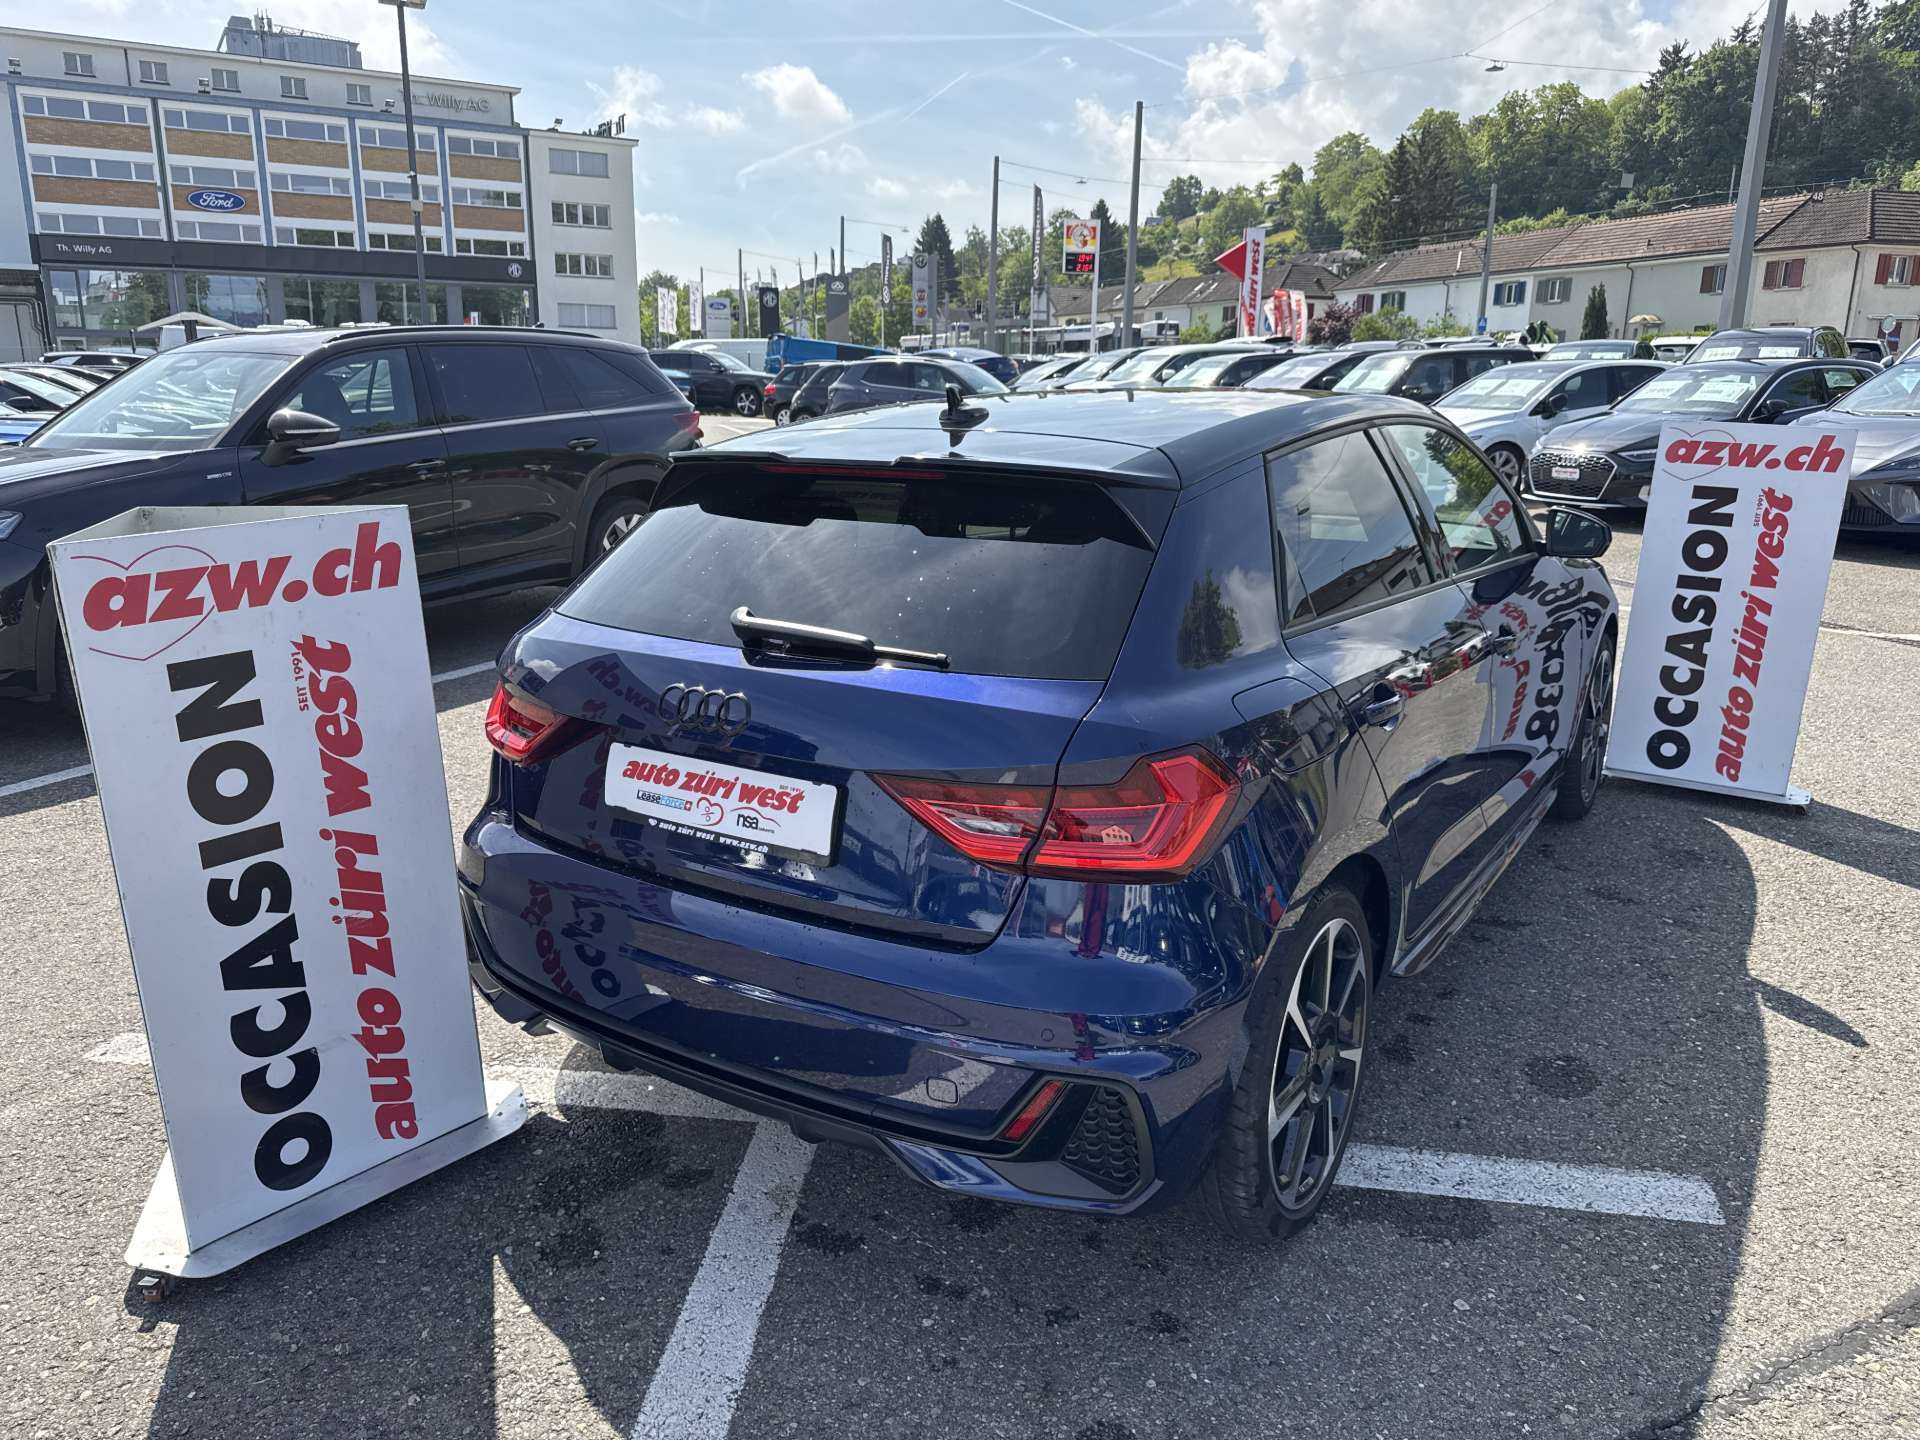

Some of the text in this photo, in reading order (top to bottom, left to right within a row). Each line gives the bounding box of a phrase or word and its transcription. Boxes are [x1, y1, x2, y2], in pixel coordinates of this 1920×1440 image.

[427, 92, 464, 113] Willy
[466, 97, 490, 113] AG
[199, 191, 234, 208] Ford
[56, 243, 113, 255] Th. Willy AG
[1665, 434, 1846, 473] azw.ch
[1753, 494, 1764, 527] SEIT 1991
[82, 521, 402, 632] azw.ch
[1646, 485, 1739, 770] OCCASION
[1715, 487, 1793, 783] auto züri west
[292, 651, 309, 712] SEIT 1991
[622, 760, 805, 814] auto züri west
[658, 821, 677, 832] auto
[696, 831, 715, 841] west
[719, 836, 769, 854] www.azw.ch
[736, 813, 759, 830] nsa
[290, 634, 419, 1140] auto züri west
[166, 649, 333, 1192] OCCASION
